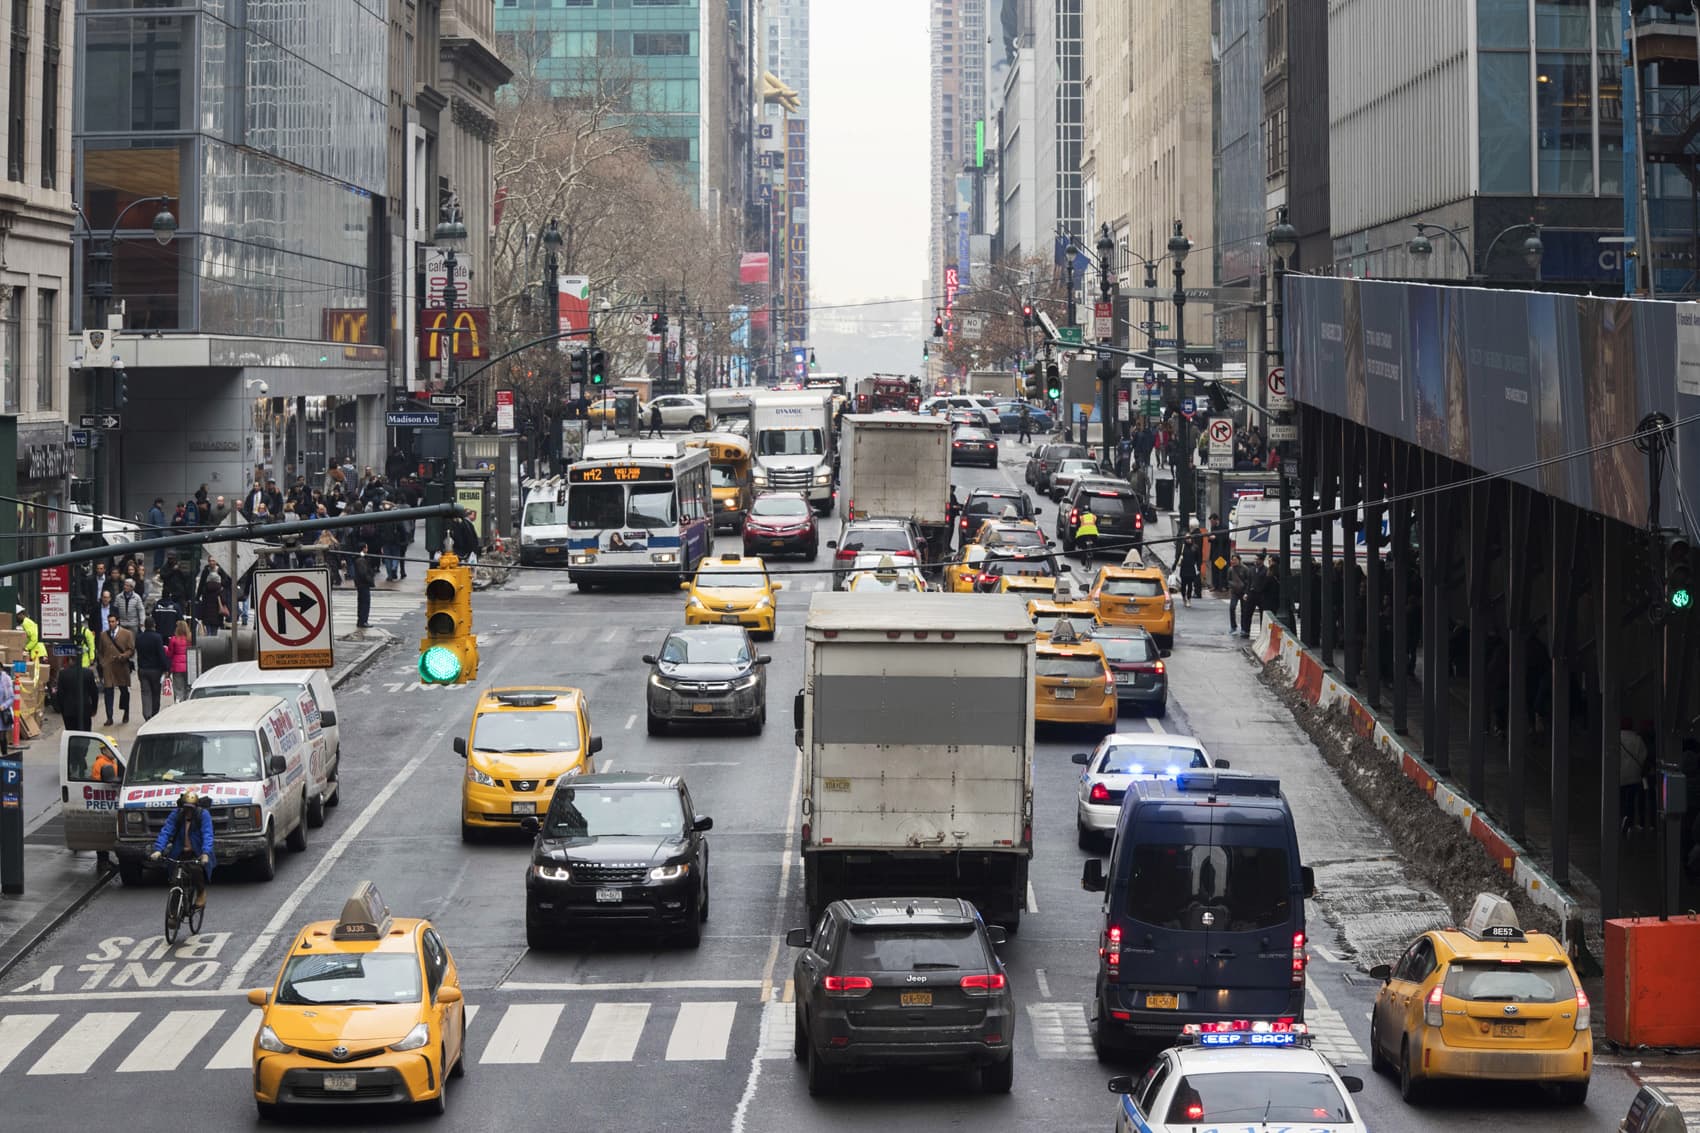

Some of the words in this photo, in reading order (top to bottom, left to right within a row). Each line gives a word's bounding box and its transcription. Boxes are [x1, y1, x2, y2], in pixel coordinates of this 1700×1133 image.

[967, 319, 978, 327] NO
[388, 415, 422, 424] Madison
[423, 415, 438, 424] Ave
[43, 594, 49, 604] 3
[1492, 927, 1513, 936] 8E52
[86, 932, 232, 962] BUS
[14, 961, 222, 992] ONLY
[906, 974, 928, 984] Jeep
[1251, 1034, 1294, 1044] BACK
